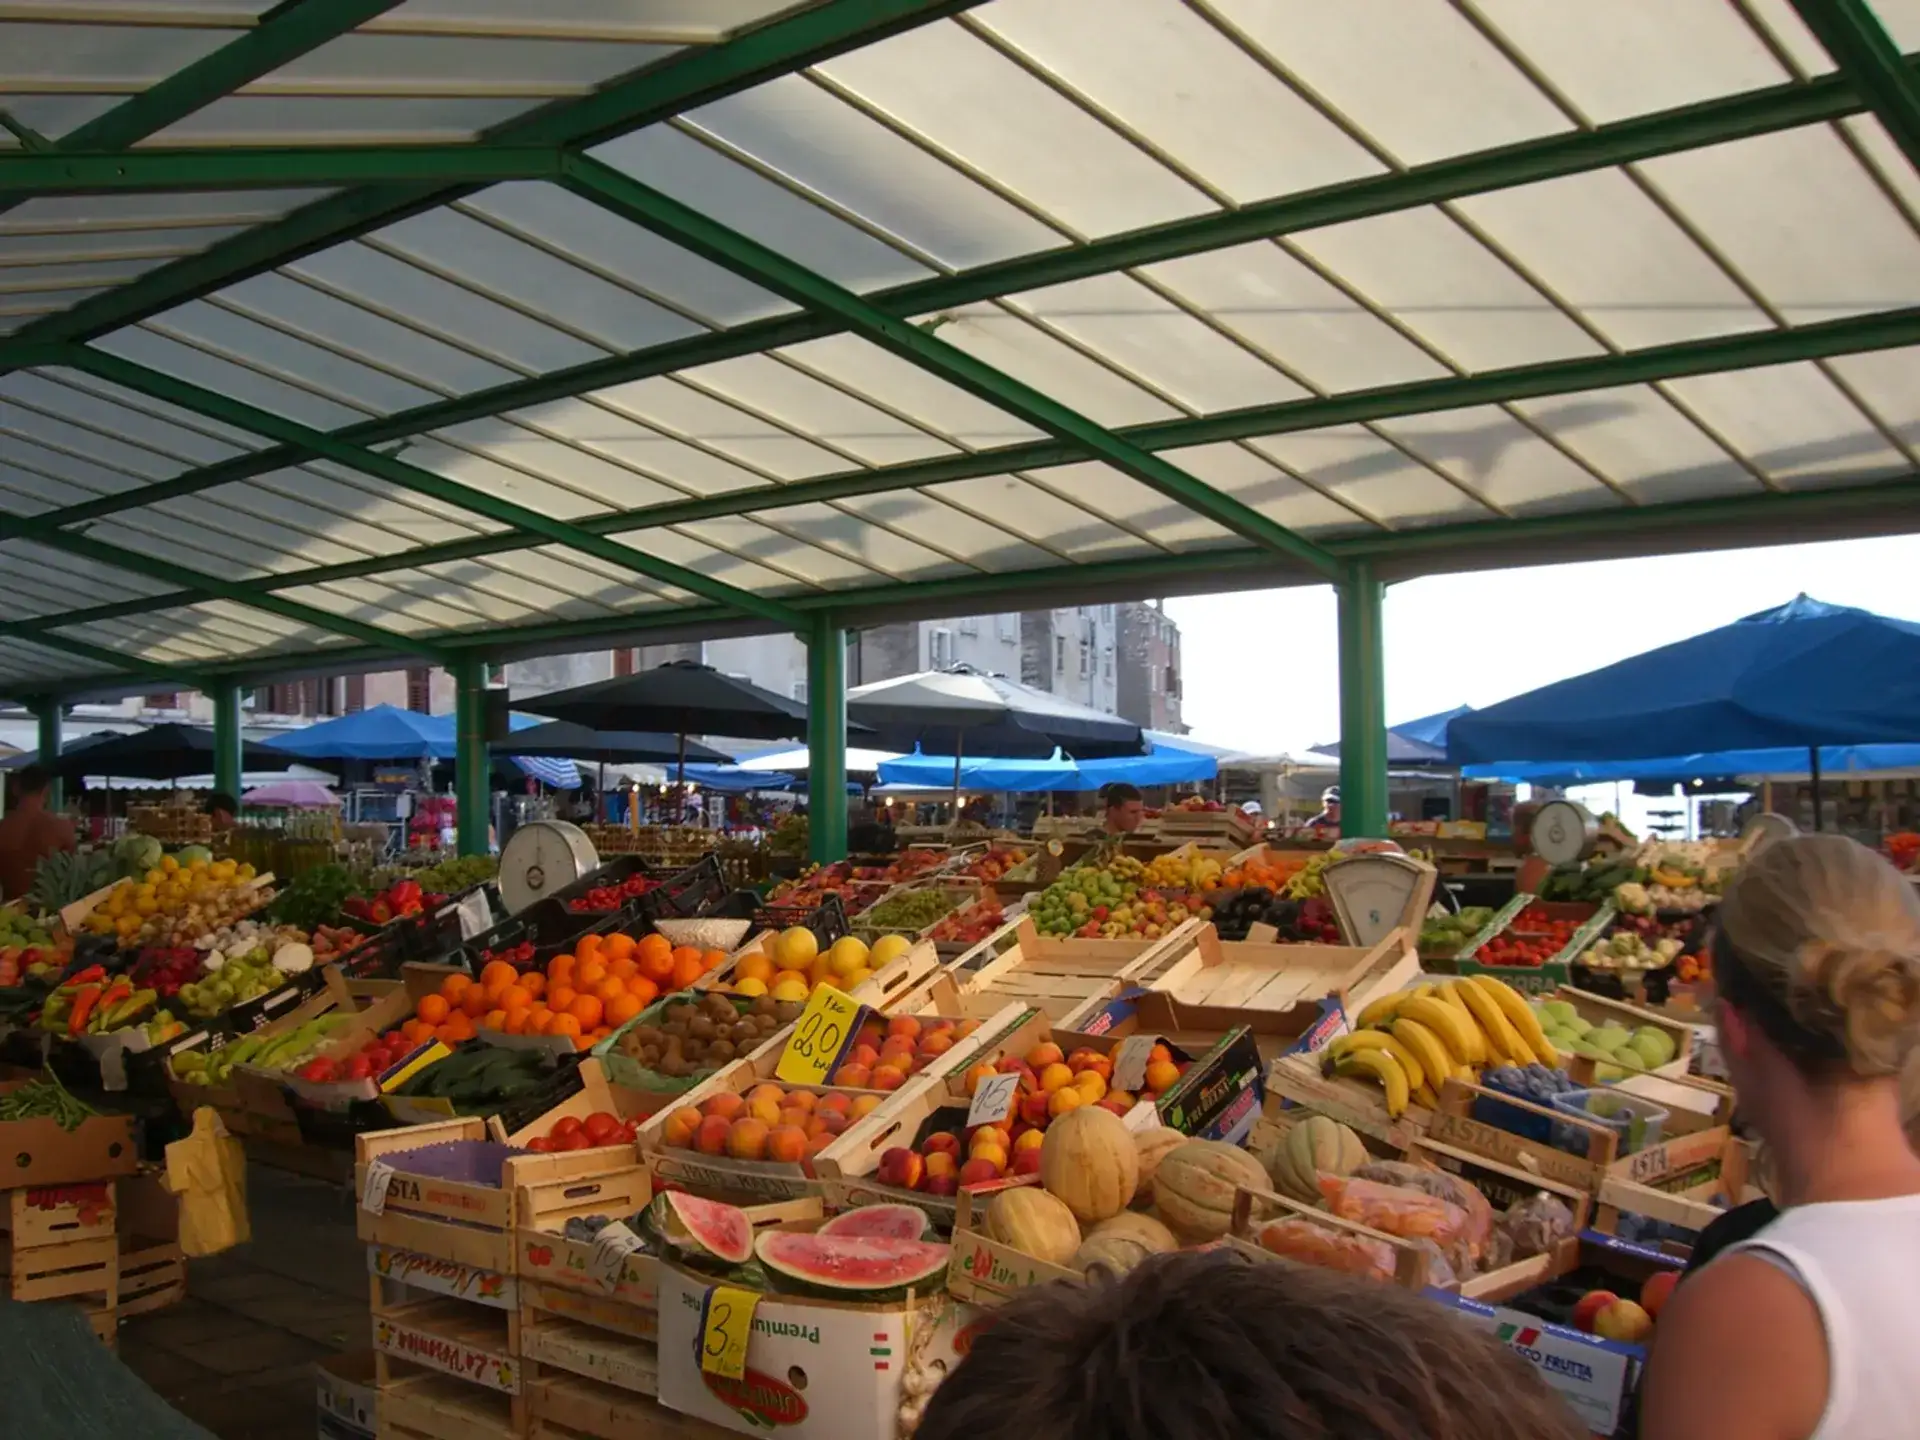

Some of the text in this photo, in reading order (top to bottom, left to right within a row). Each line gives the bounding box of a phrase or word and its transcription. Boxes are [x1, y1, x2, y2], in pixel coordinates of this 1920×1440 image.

[793, 1012, 840, 1057] 20
[386, 1177, 420, 1201] STA
[705, 1302, 732, 1357] 3
[750, 1317, 820, 1344] Premiu
[1545, 1354, 1594, 1379] FRUTTA
